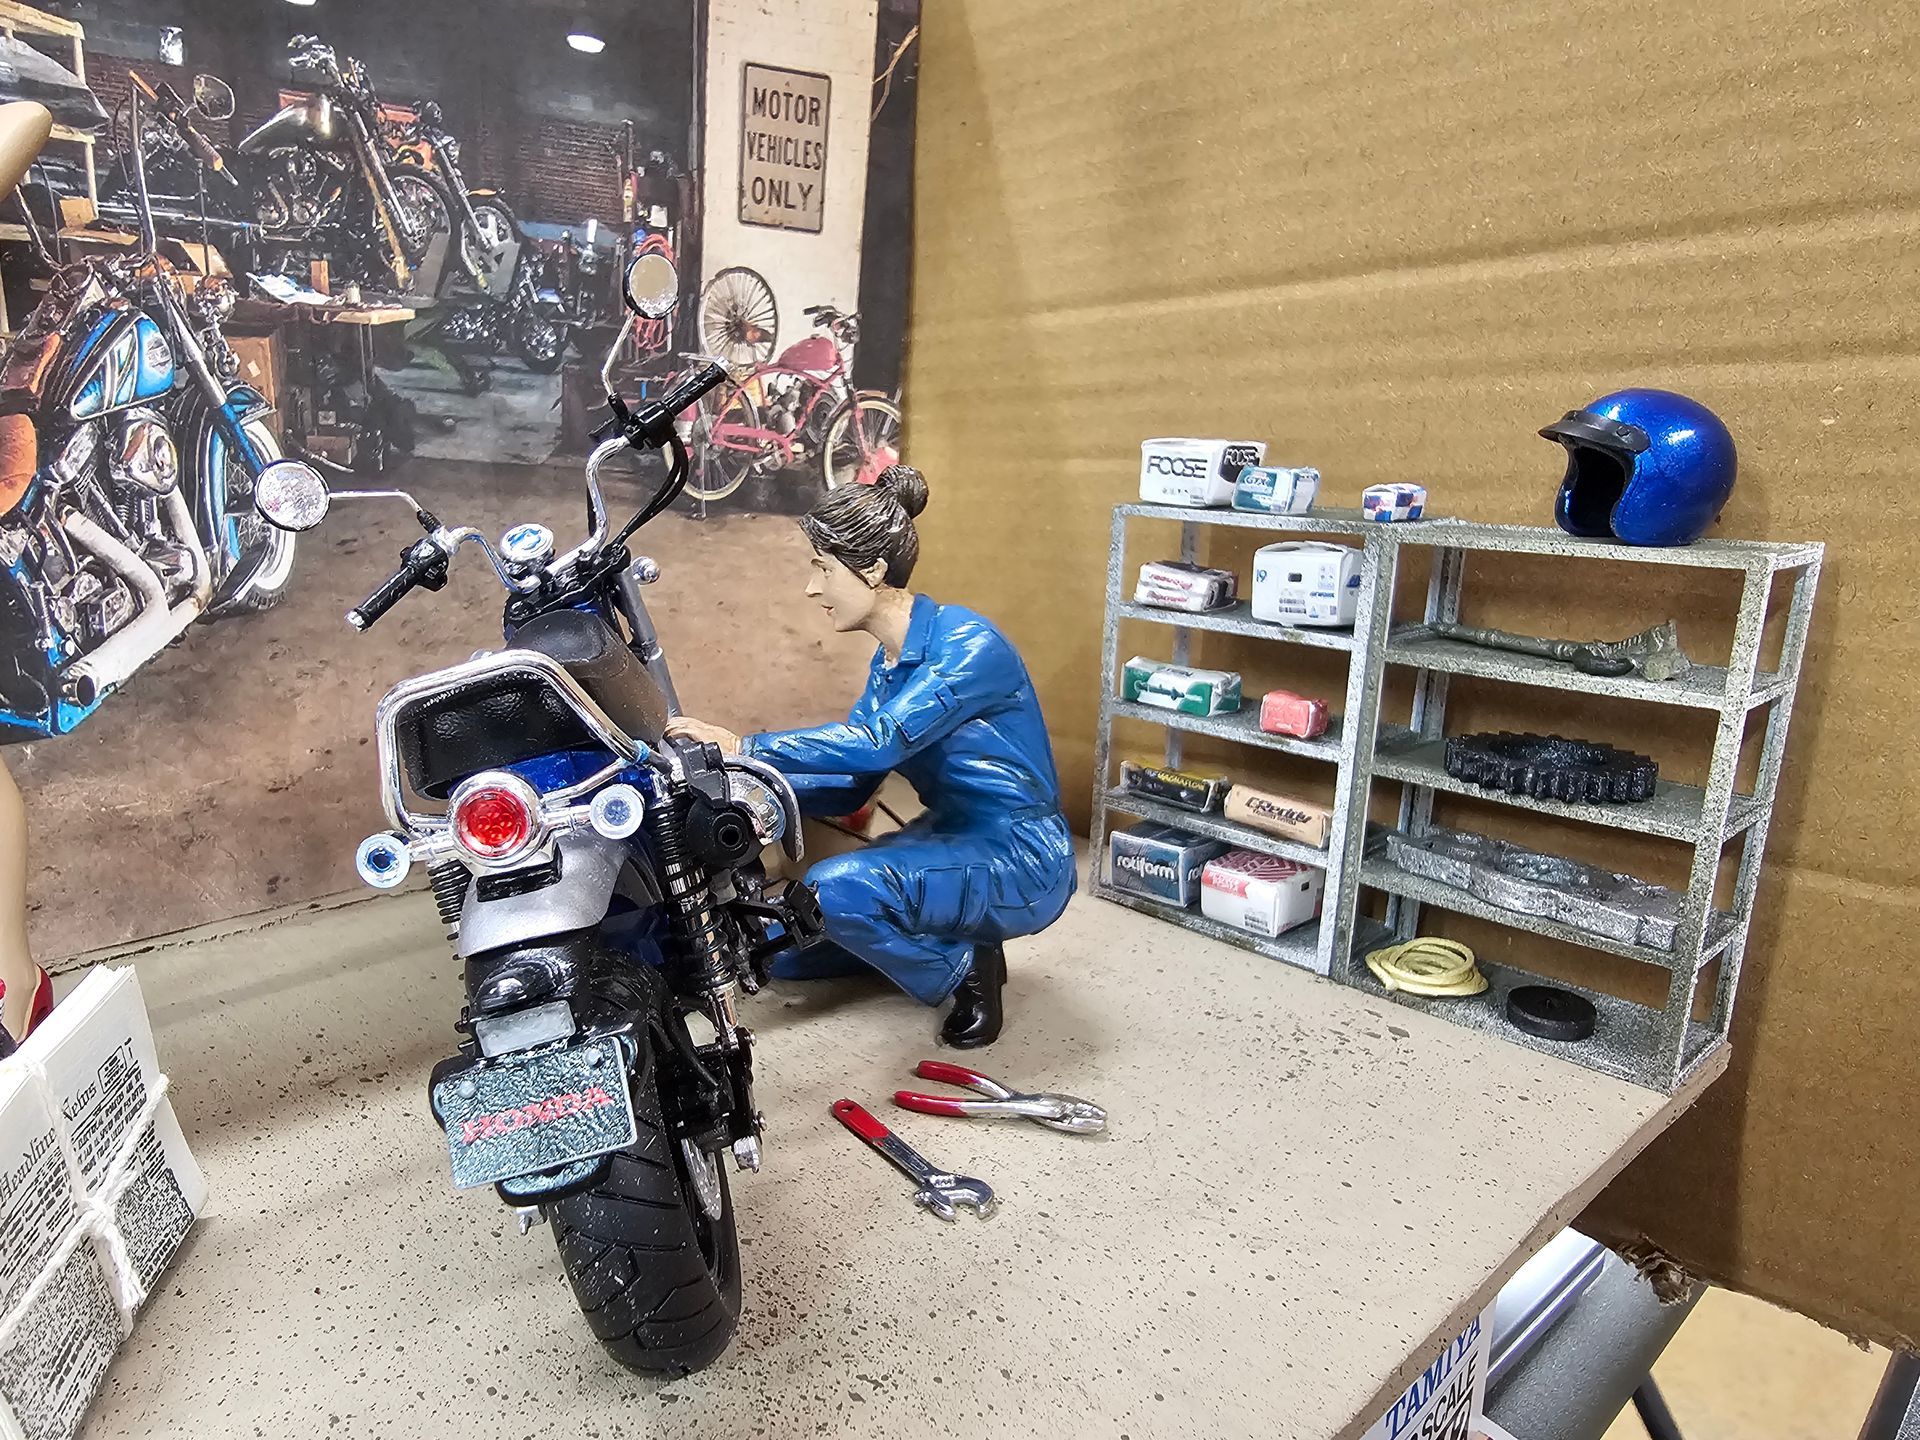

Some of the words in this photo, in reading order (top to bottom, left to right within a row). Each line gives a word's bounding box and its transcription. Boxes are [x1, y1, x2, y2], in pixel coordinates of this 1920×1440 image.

[752, 87, 821, 127] MOTOR
[747, 131, 823, 171] VEHICLES
[751, 176, 814, 212] ONLY
[1147, 455, 1208, 479] FOOSE
[1117, 855, 1176, 882] rotiform
[460, 1086, 615, 1145] HONDA
[1385, 1314, 1481, 1440] TAMIYA
[1421, 1350, 1479, 1440] SCALE
